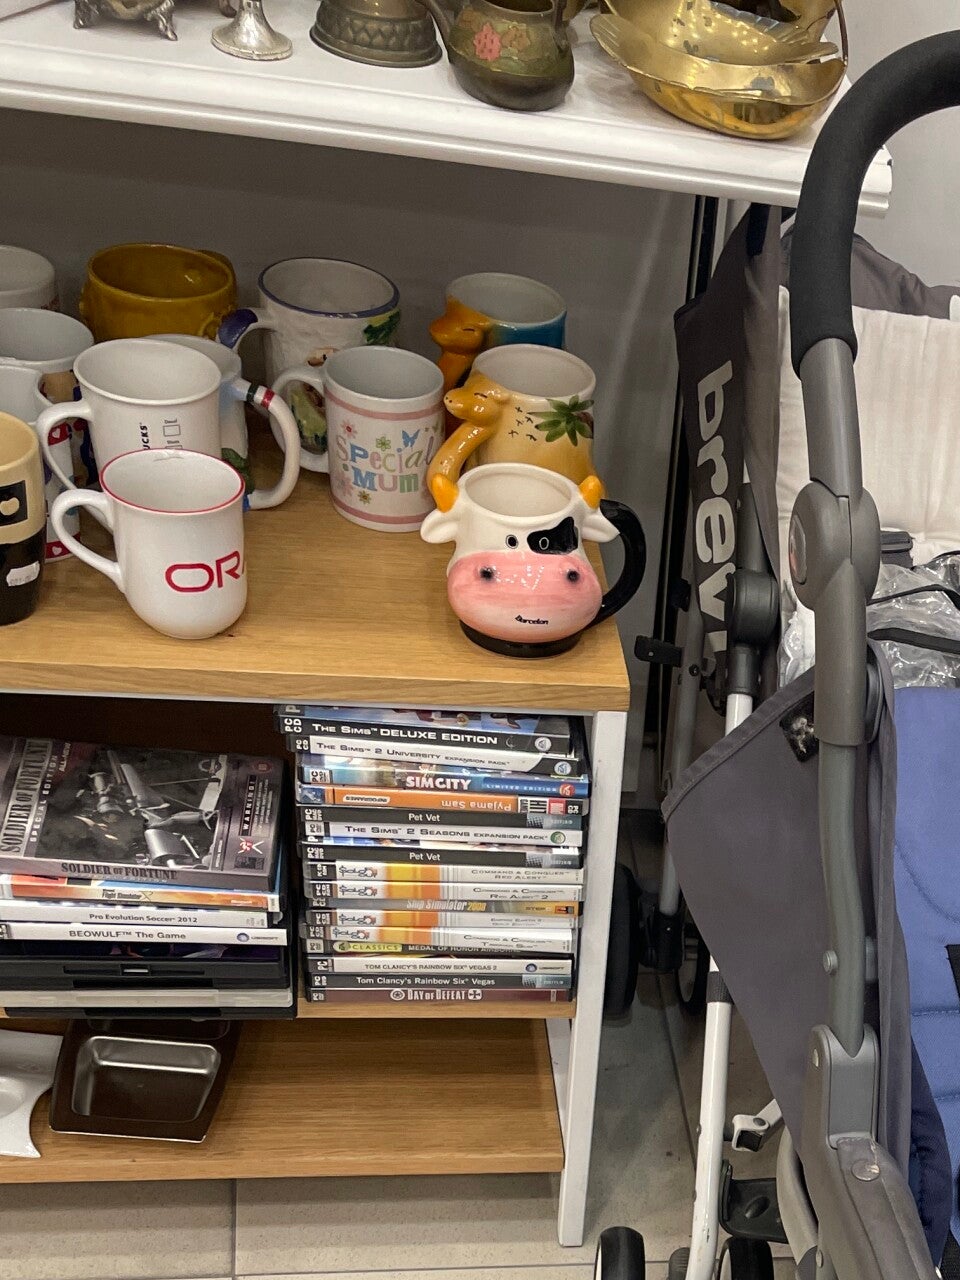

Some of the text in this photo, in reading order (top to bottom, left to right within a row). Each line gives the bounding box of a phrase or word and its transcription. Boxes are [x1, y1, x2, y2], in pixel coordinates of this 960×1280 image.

[139, 423, 151, 450] UCKS
[164, 551, 244, 593] OR
[380, 728, 437, 740] DELUXE
[441, 733, 498, 744] EDITION
[374, 747, 383, 755] 2
[386, 749, 441, 760] UNIVERSITY
[406, 776, 472, 790] SIMCITY
[441, 800, 512, 812] Pyjama Sam
[29, 799, 47, 842] SPECIAL
[408, 813, 441, 822] Pet Vet
[420, 828, 470, 837] SEASONS
[409, 852, 441, 861] Pet Vet
[61, 862, 111, 875] SOLDIER
[124, 868, 178, 880] FORTUNE
[425, 900, 468, 911] Simulator
[356, 976, 374, 984] Tom
[376, 976, 412, 985] Clancy's
[414, 977, 450, 985] Rainbow
[471, 978, 496, 986] Vegas
[407, 989, 423, 1000] DAY
[435, 989, 466, 1000] DEFEAT
